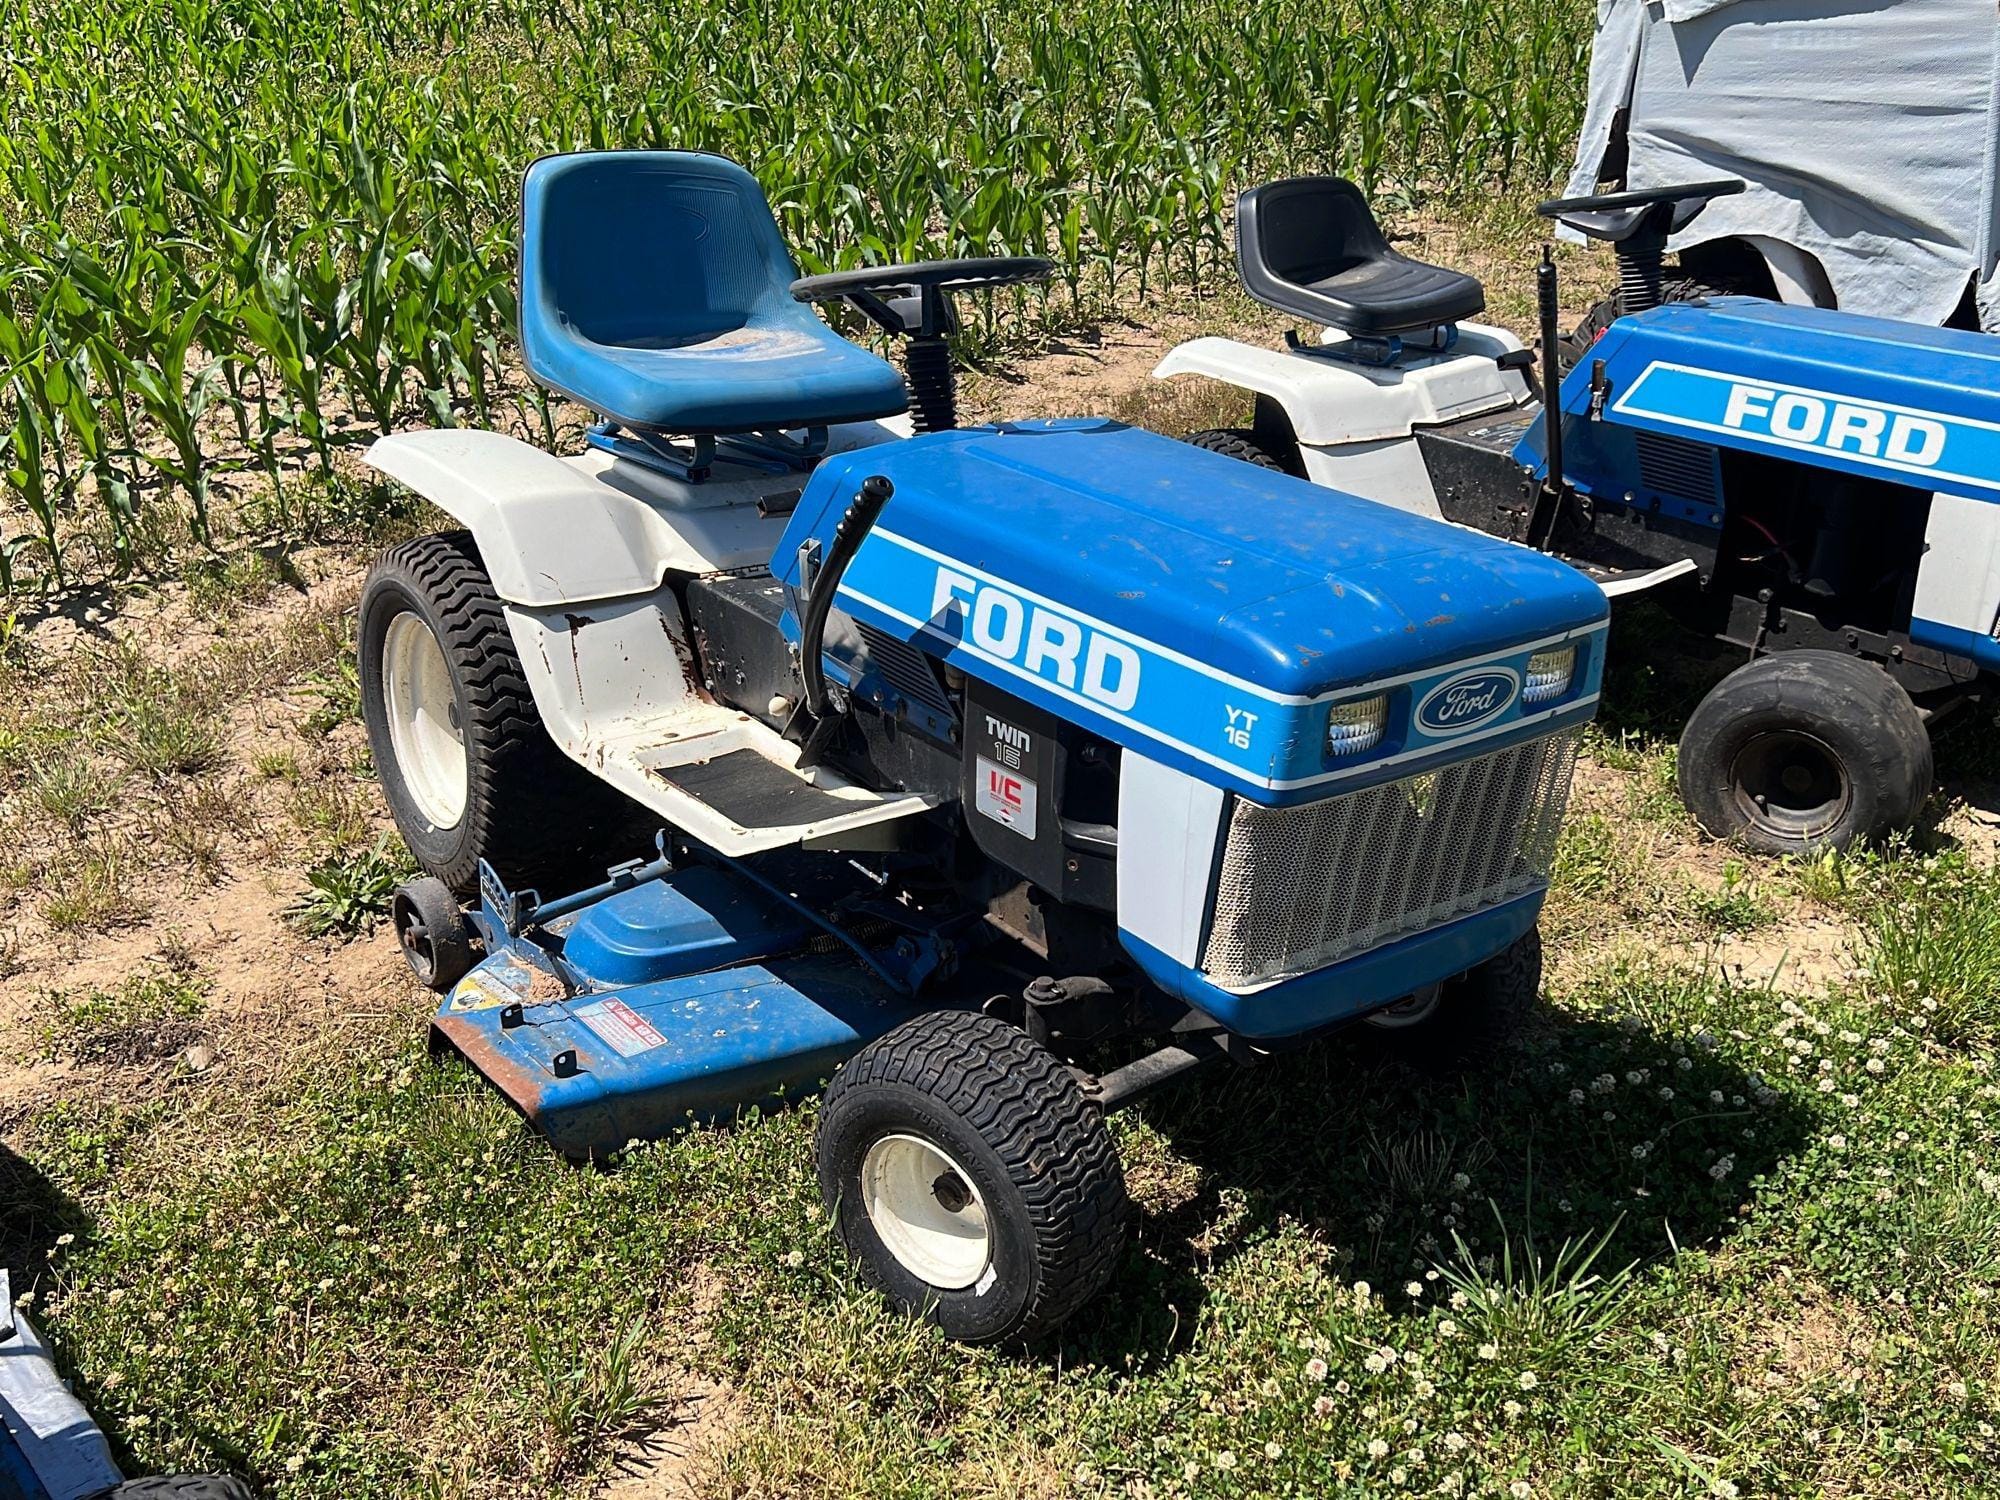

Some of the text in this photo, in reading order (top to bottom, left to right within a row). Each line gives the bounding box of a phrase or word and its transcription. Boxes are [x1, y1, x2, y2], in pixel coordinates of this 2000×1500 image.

[1722, 384, 1947, 466] FORD
[931, 566, 1141, 711] FORD
[1225, 704, 1258, 731] YT
[1439, 682, 1498, 720] Ford
[986, 715, 1030, 752] TWIN
[1224, 726, 1250, 750] 16
[995, 741, 1020, 770] 16
